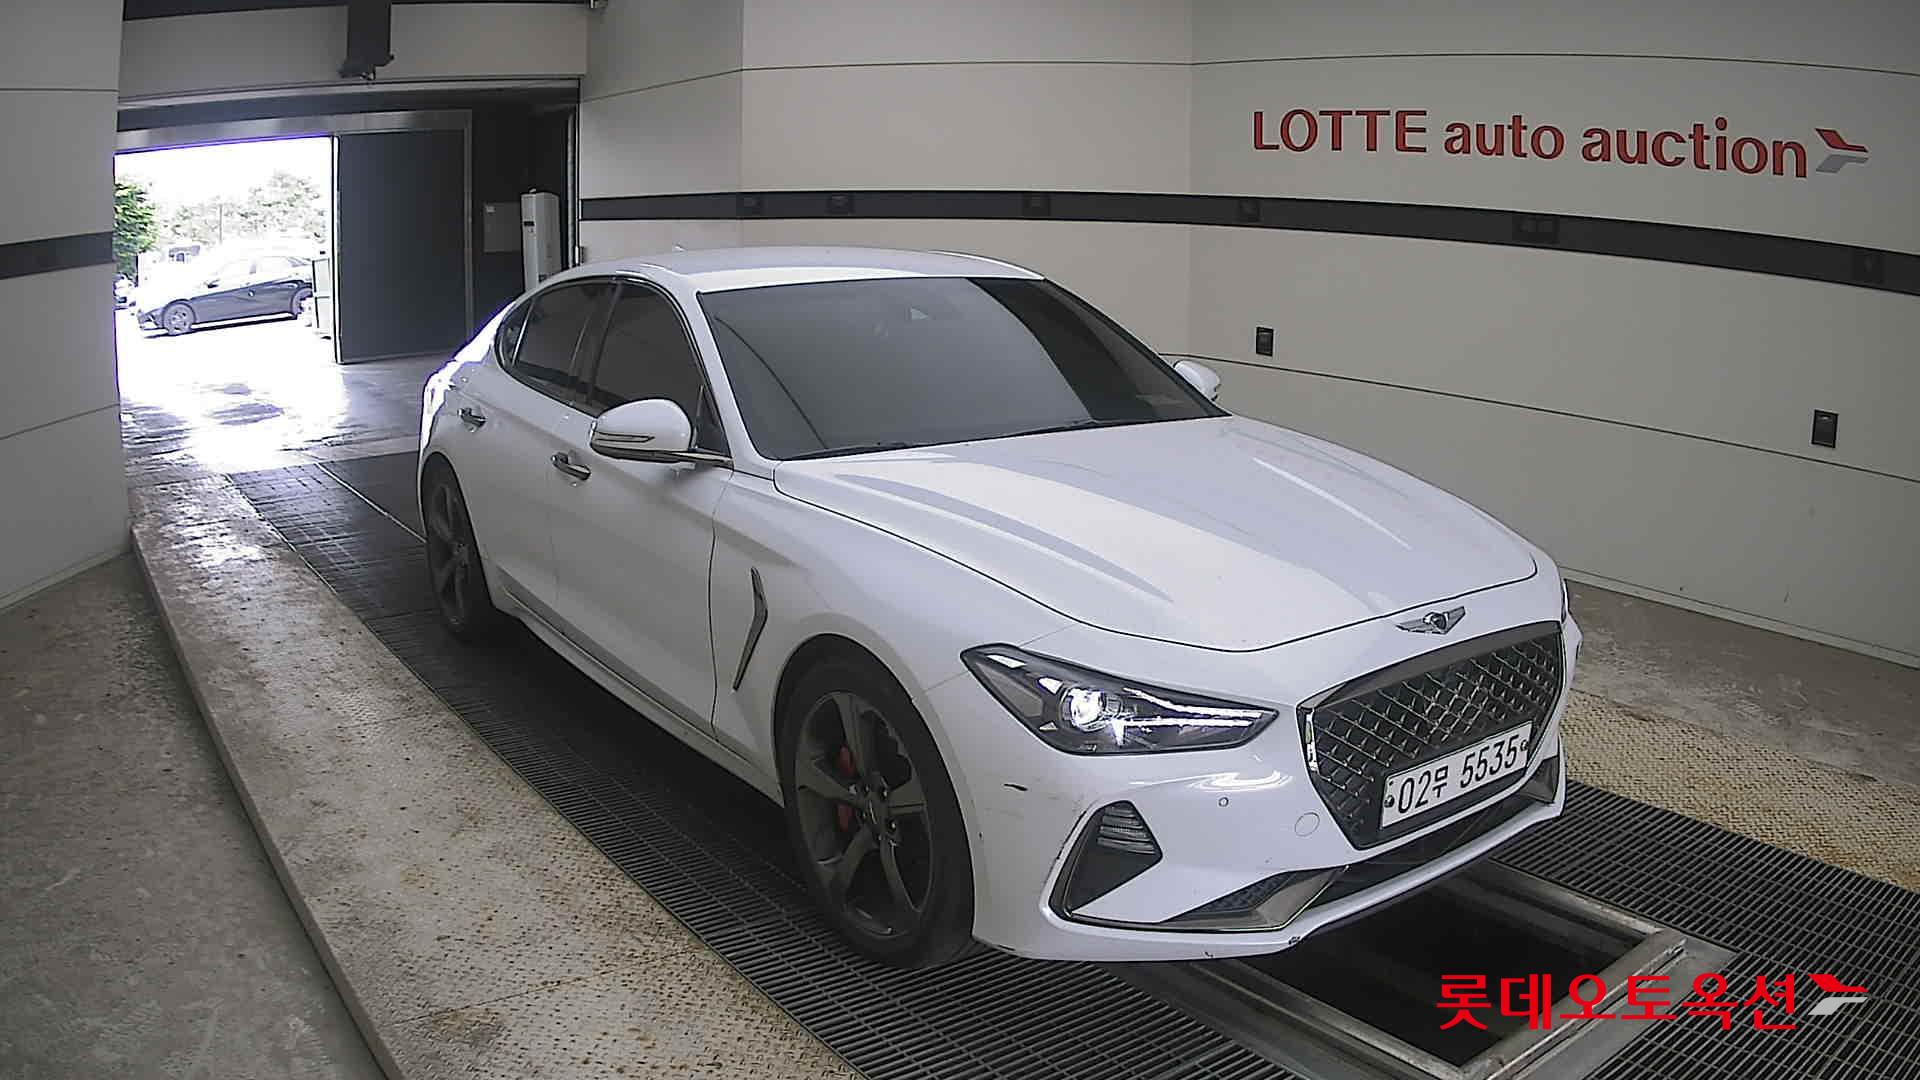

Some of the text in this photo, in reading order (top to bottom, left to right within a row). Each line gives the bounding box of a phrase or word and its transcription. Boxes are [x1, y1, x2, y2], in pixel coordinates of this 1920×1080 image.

[1253, 108, 1808, 179] LOTTE auto auction
[1398, 735, 1519, 813] 02무 5535
